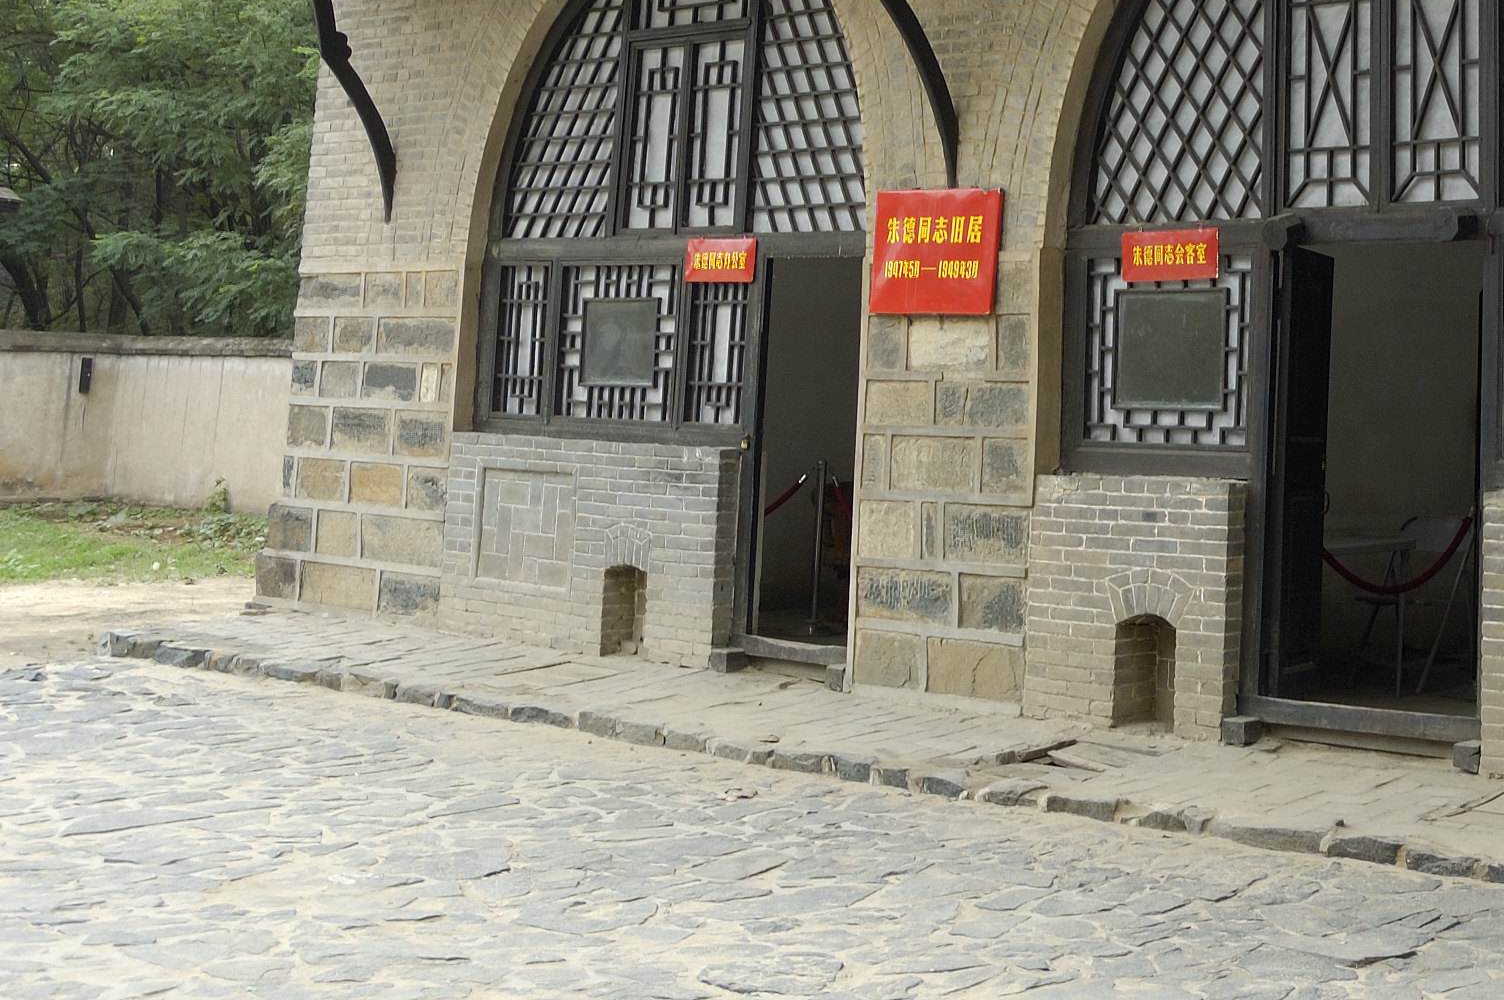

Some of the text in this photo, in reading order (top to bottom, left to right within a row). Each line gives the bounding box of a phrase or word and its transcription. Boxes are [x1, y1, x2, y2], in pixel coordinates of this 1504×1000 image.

[886, 215, 984, 244] 朱德同志旧居
[1132, 242, 1208, 266] 朱德同志会客室
